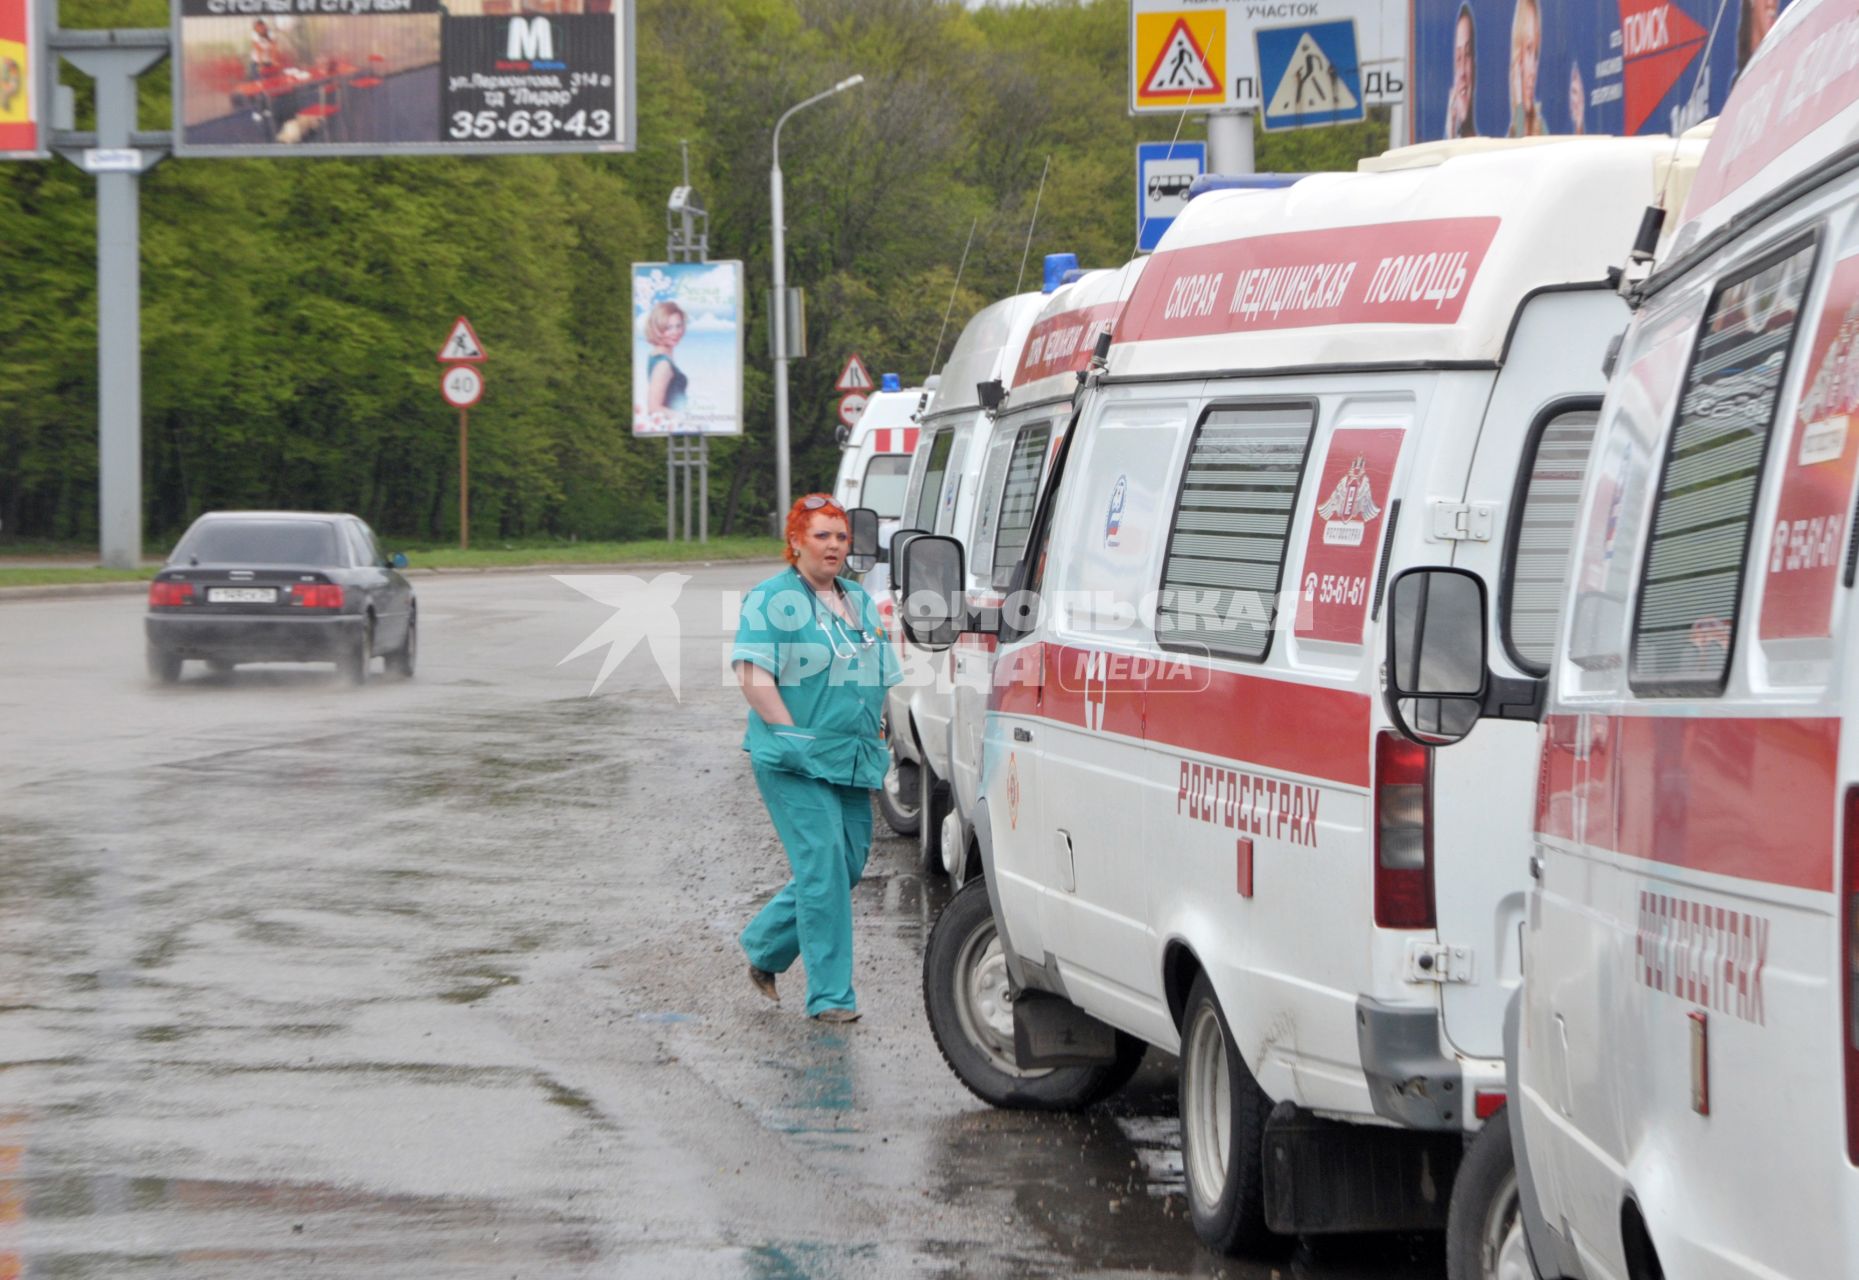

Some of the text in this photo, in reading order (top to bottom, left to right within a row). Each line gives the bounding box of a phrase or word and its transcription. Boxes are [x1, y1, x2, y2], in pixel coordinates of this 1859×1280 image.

[1246, 5, 1319, 19] УЧАСТОК
[1623, 3, 1670, 57] ПОИСК
[1164, 251, 1469, 323] СКОРАЯ МЕДИЦИНСКАЯ ПОМОЩЬ
[450, 377, 474, 394] 40
[1319, 574, 1367, 606] 55-61-61
[1177, 760, 1320, 848] РОСГОССТРАХ
